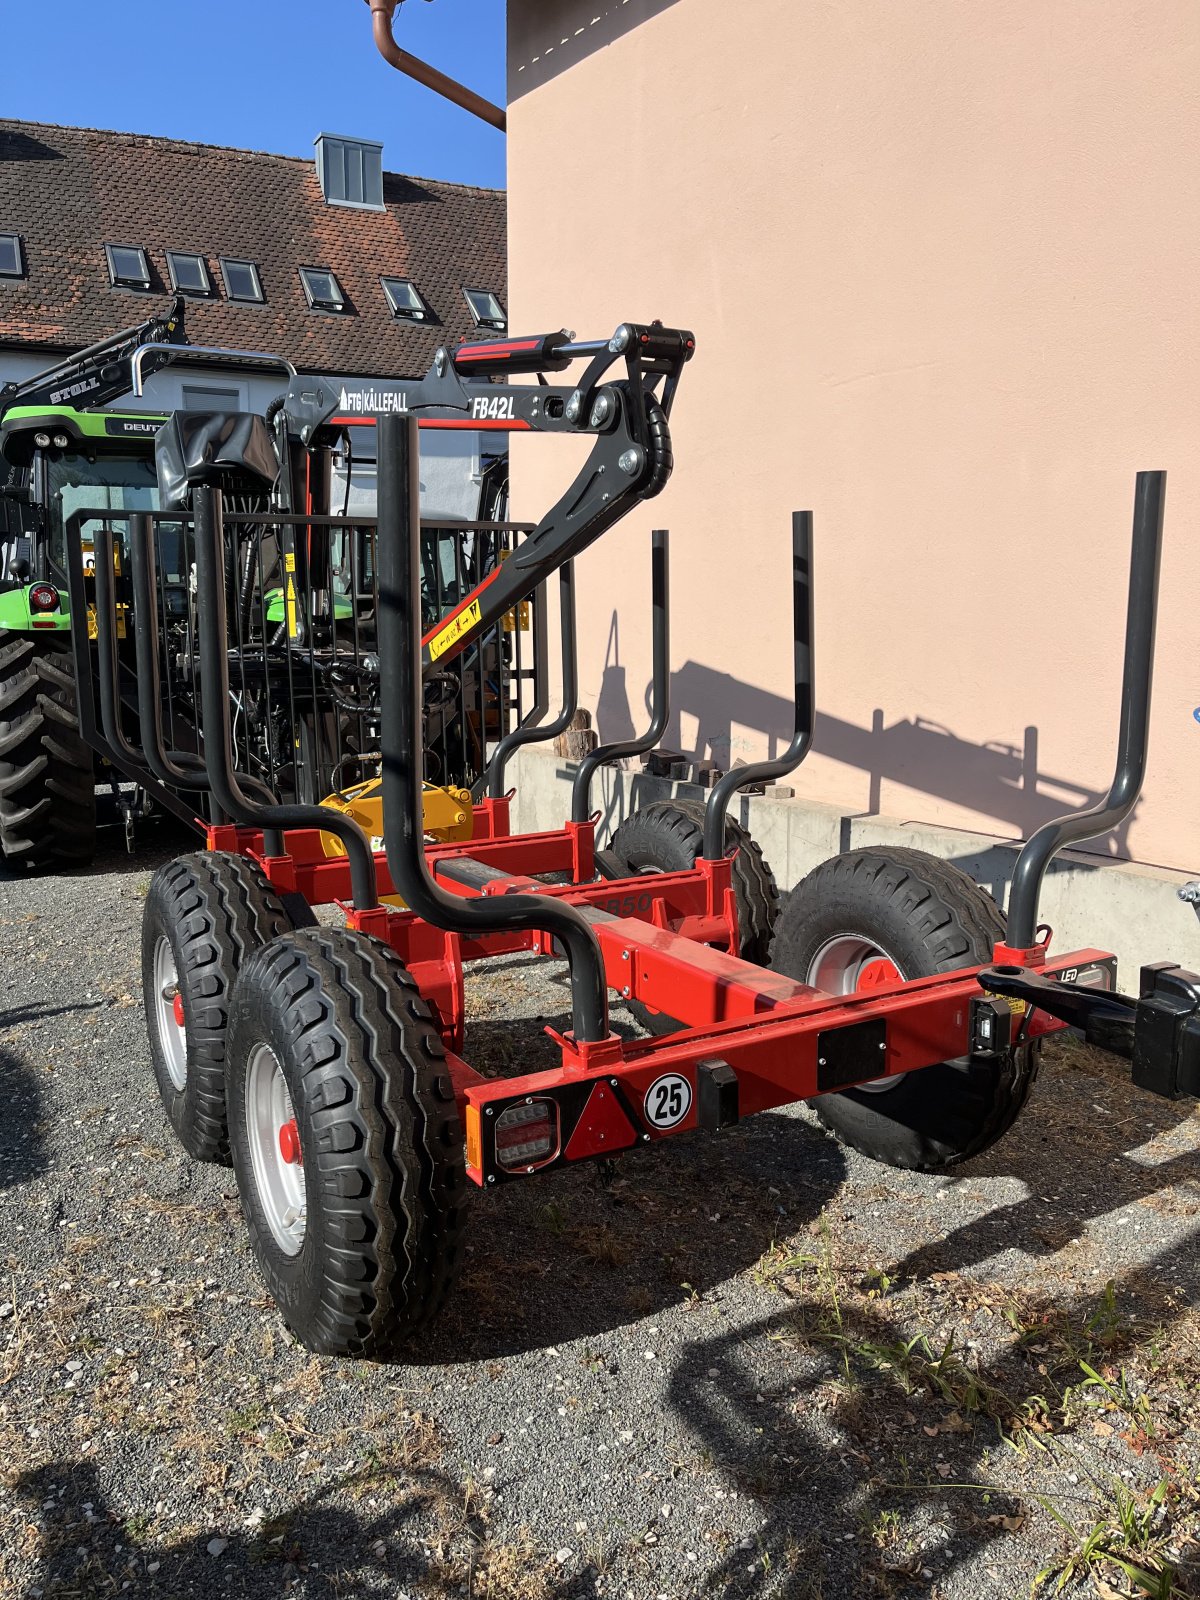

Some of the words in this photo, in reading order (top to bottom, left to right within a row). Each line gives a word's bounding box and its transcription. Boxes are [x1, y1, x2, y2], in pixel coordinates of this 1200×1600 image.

[50, 377, 100, 404] STOLL
[472, 396, 515, 419] FB42L
[123, 423, 164, 432] DEUT
[1061, 968, 1078, 982] LED
[655, 1082, 683, 1121] 25
